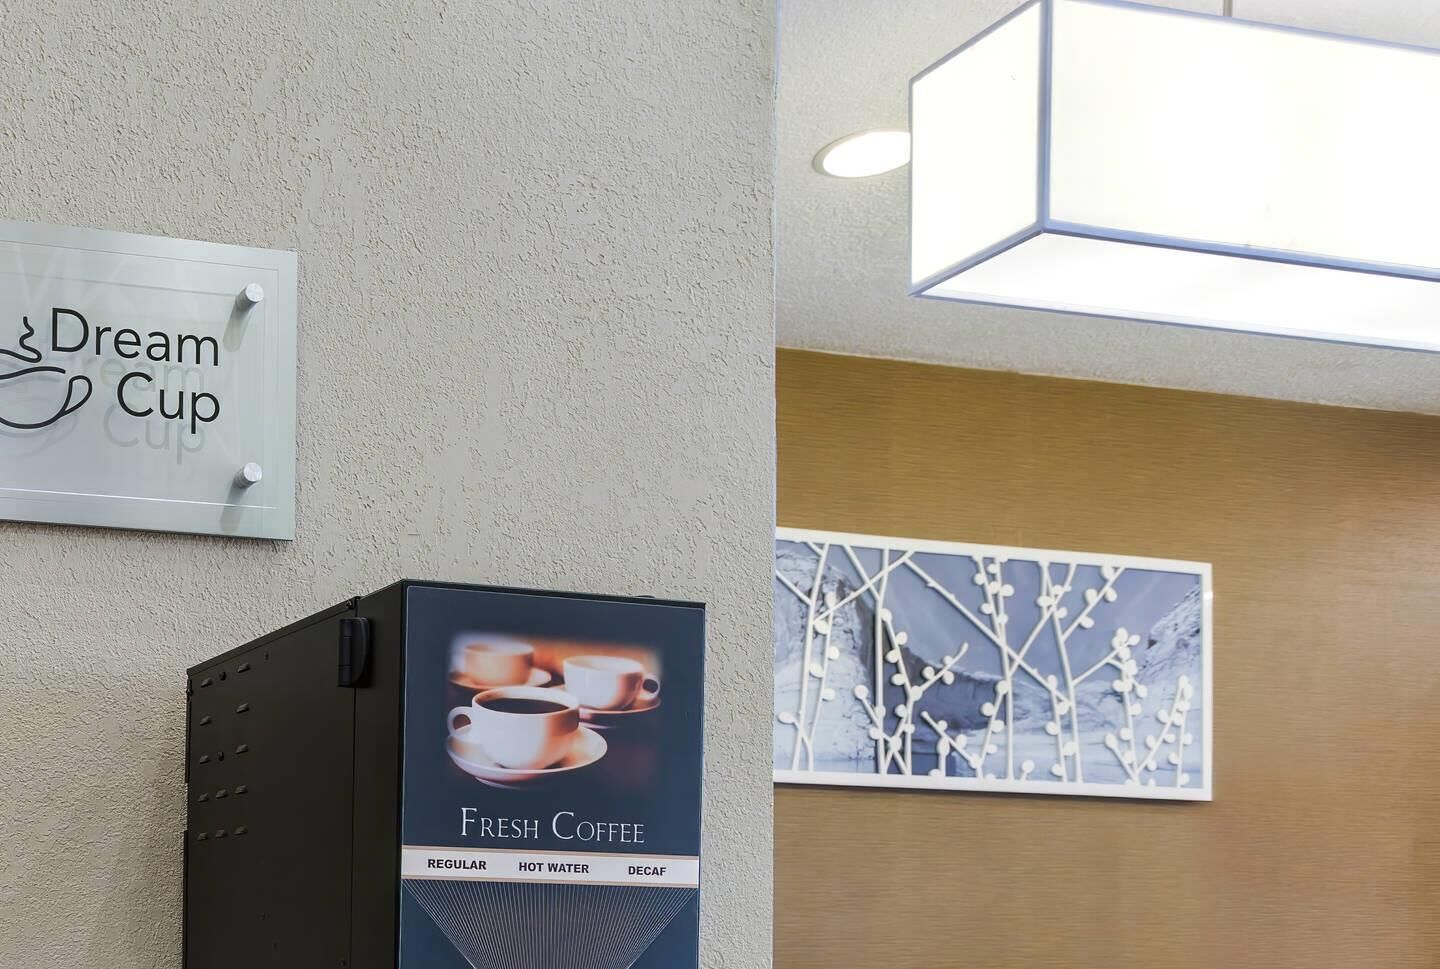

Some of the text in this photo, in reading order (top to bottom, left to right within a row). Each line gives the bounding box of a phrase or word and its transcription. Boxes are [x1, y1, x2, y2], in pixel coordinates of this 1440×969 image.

[52, 308, 218, 366] Dream
[117, 372, 220, 434] Cup
[461, 808, 645, 843] FRESH COFFEE
[428, 859, 487, 870] REGULAR
[519, 862, 589, 874] HOT WATER
[628, 865, 666, 876] DECAF
